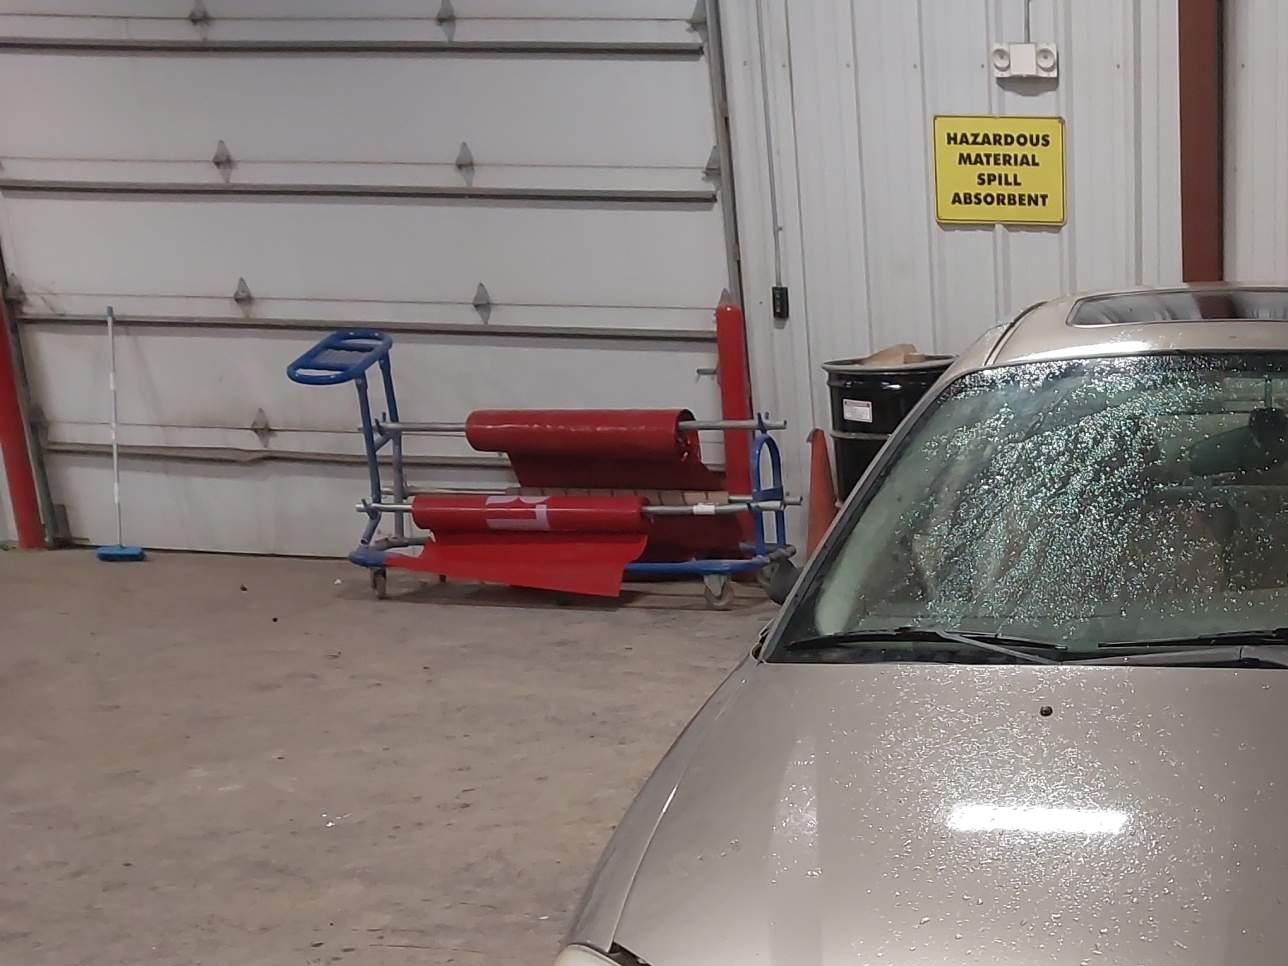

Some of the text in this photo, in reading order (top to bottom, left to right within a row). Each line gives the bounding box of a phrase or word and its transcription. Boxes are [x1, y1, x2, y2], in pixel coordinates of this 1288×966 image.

[946, 132, 1050, 148] HAZARDOUS
[957, 152, 1040, 167] MATERIAL
[977, 172, 1022, 187] SPILL
[951, 192, 1049, 207] ABSORBENT
